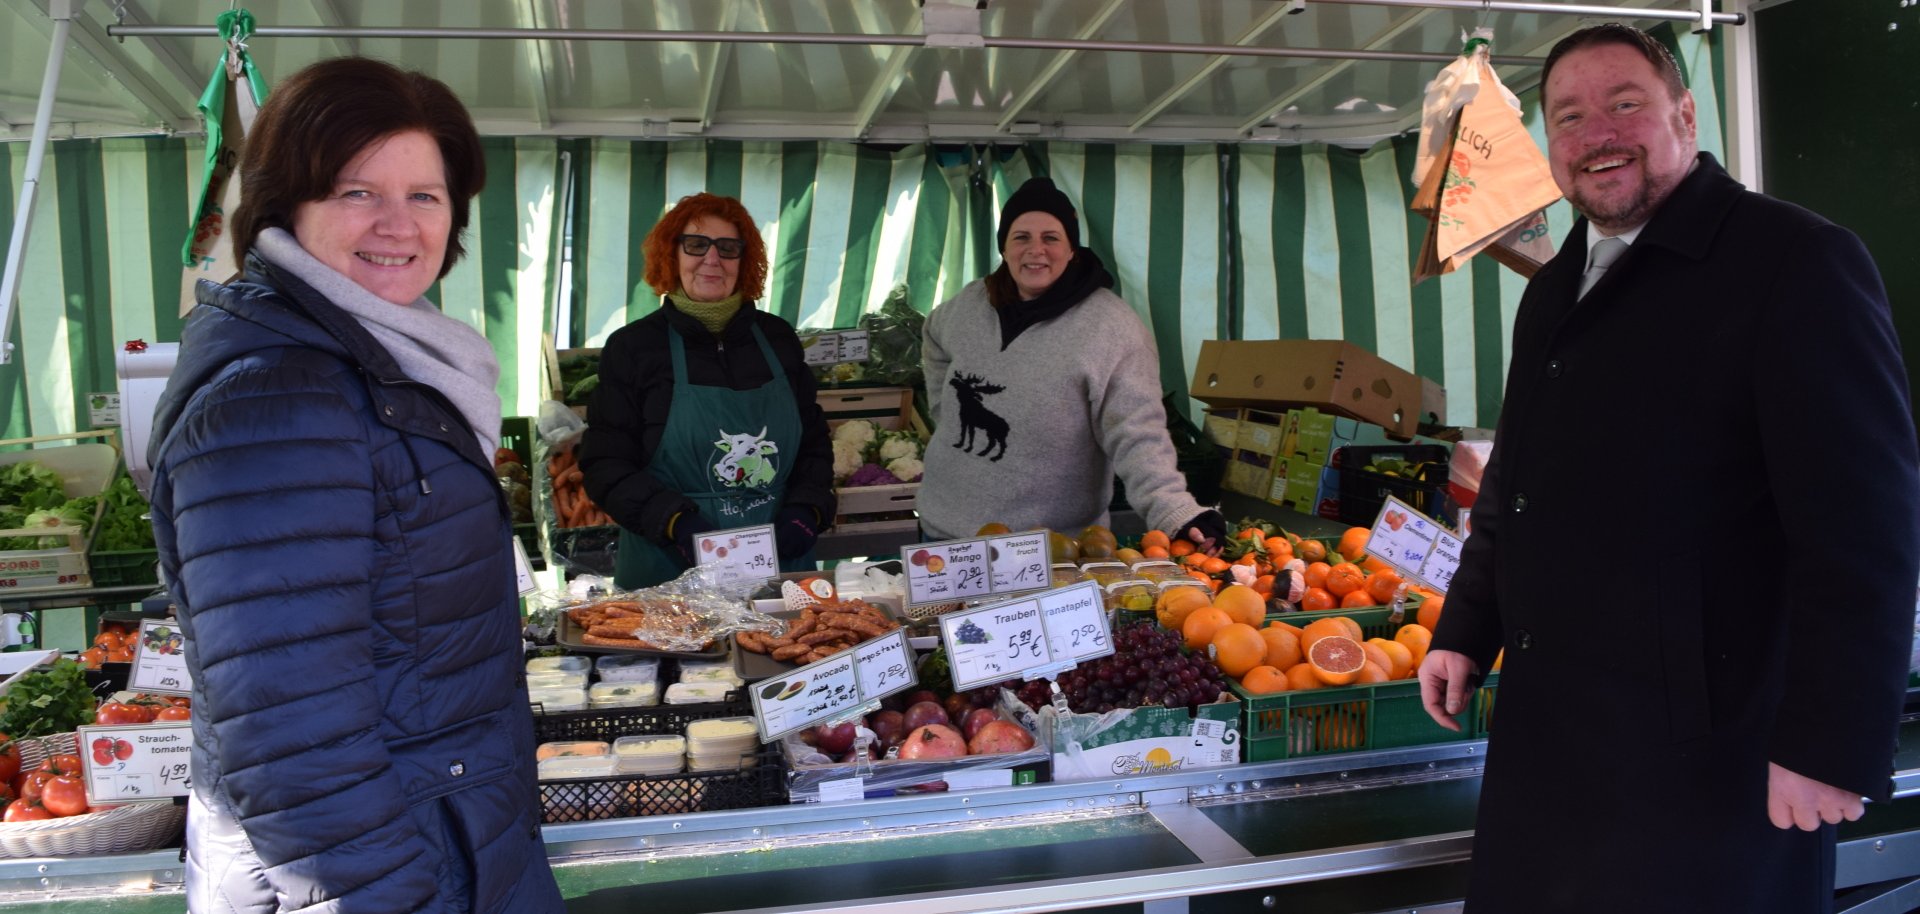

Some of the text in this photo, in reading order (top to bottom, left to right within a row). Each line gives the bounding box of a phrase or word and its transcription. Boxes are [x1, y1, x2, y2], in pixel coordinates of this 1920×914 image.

[1005, 538, 1041, 549] Passions-
[1016, 547, 1038, 556] frucht
[950, 553, 982, 564] Mango
[994, 608, 1036, 626] Trauben
[1030, 634, 1043, 658] €
[812, 663, 850, 683] Avocado
[138, 734, 181, 743] Strauch-
[151, 745, 192, 754] tomaten
